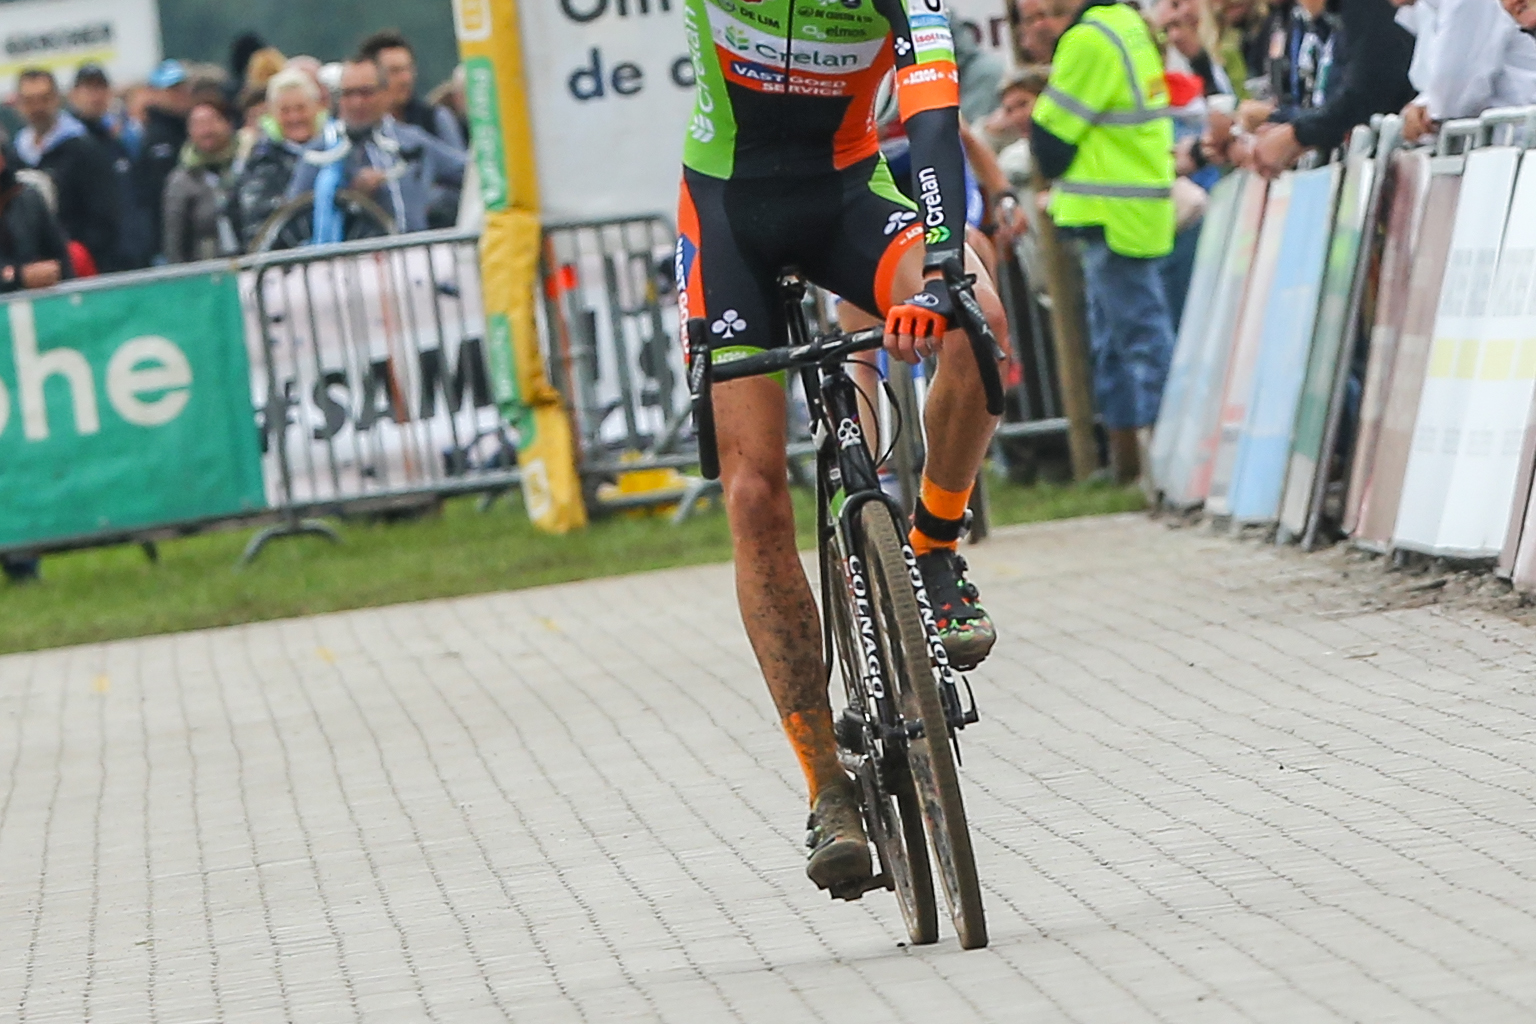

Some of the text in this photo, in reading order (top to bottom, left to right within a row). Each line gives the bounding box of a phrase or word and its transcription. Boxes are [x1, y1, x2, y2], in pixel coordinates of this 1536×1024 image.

[568, 48, 642, 103] de
[734, 62, 847, 88] VAST GOED
[755, 43, 859, 67] Crelan
[761, 81, 843, 95] SERVICE
[918, 166, 945, 227] Crelan
[0, 298, 195, 442] he
[849, 553, 885, 700] COLNAGO
[901, 543, 955, 685] COLNAGO
